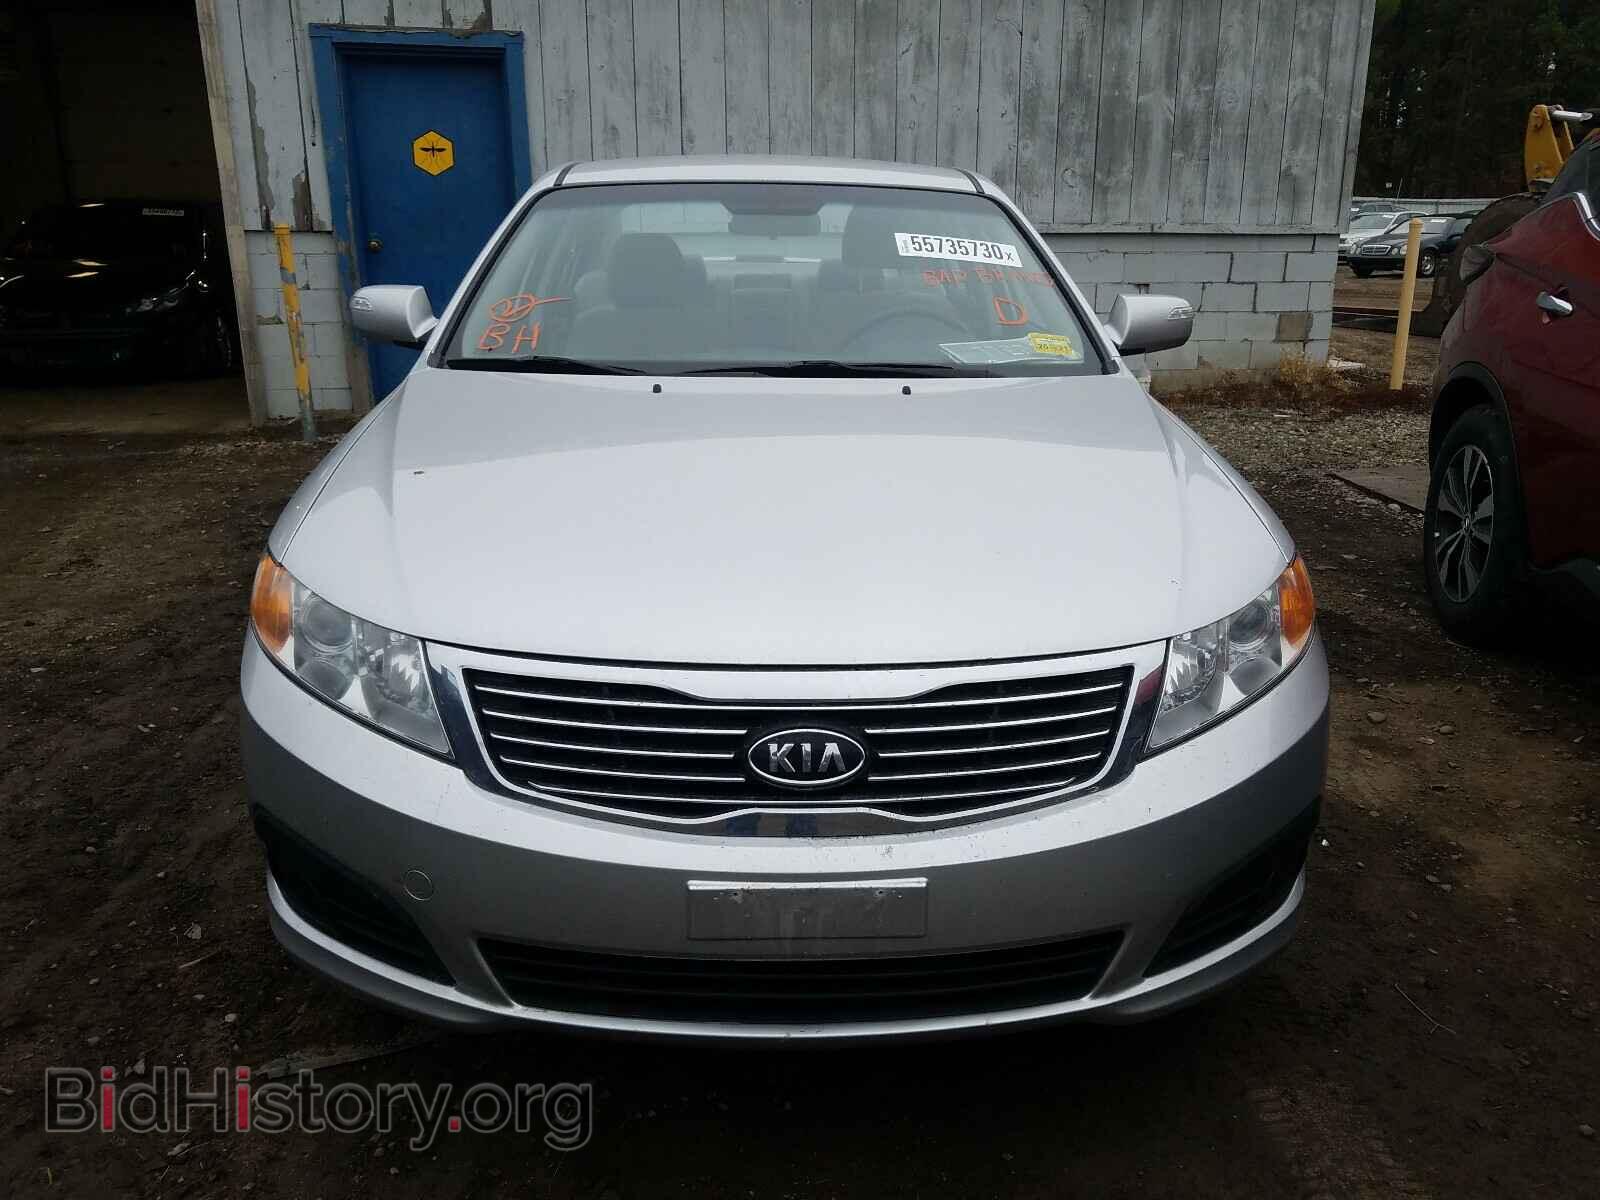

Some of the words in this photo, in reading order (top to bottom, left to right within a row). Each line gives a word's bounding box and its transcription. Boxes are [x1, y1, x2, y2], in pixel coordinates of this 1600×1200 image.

[910, 235, 1004, 260] 55735730
[992, 296, 1029, 326] D
[767, 742, 847, 773] KIA
